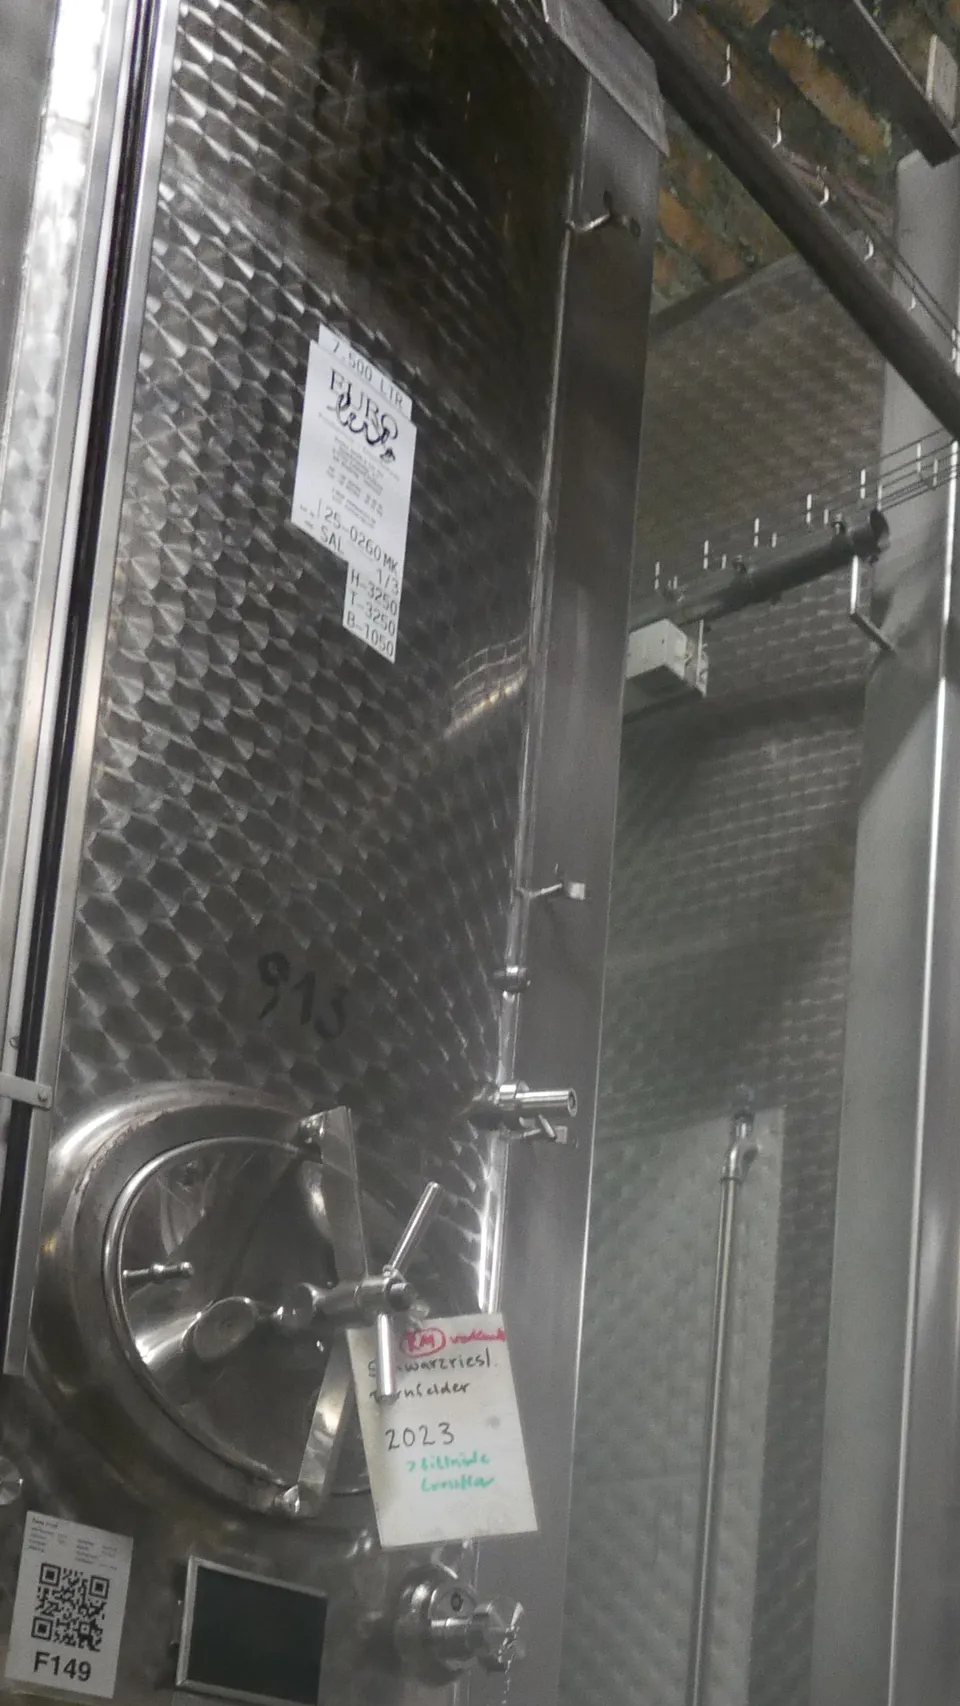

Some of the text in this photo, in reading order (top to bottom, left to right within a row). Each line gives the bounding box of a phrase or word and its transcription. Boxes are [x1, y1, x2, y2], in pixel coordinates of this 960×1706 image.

[330, 368, 399, 441] EURO
[320, 525, 344, 555] SAL
[351, 568, 397, 617] H-3250
[351, 590, 396, 638] T-3250
[347, 611, 394, 658] B-1050
[385, 1421, 455, 1450] 2023
[34, 1651, 92, 1682] F149
